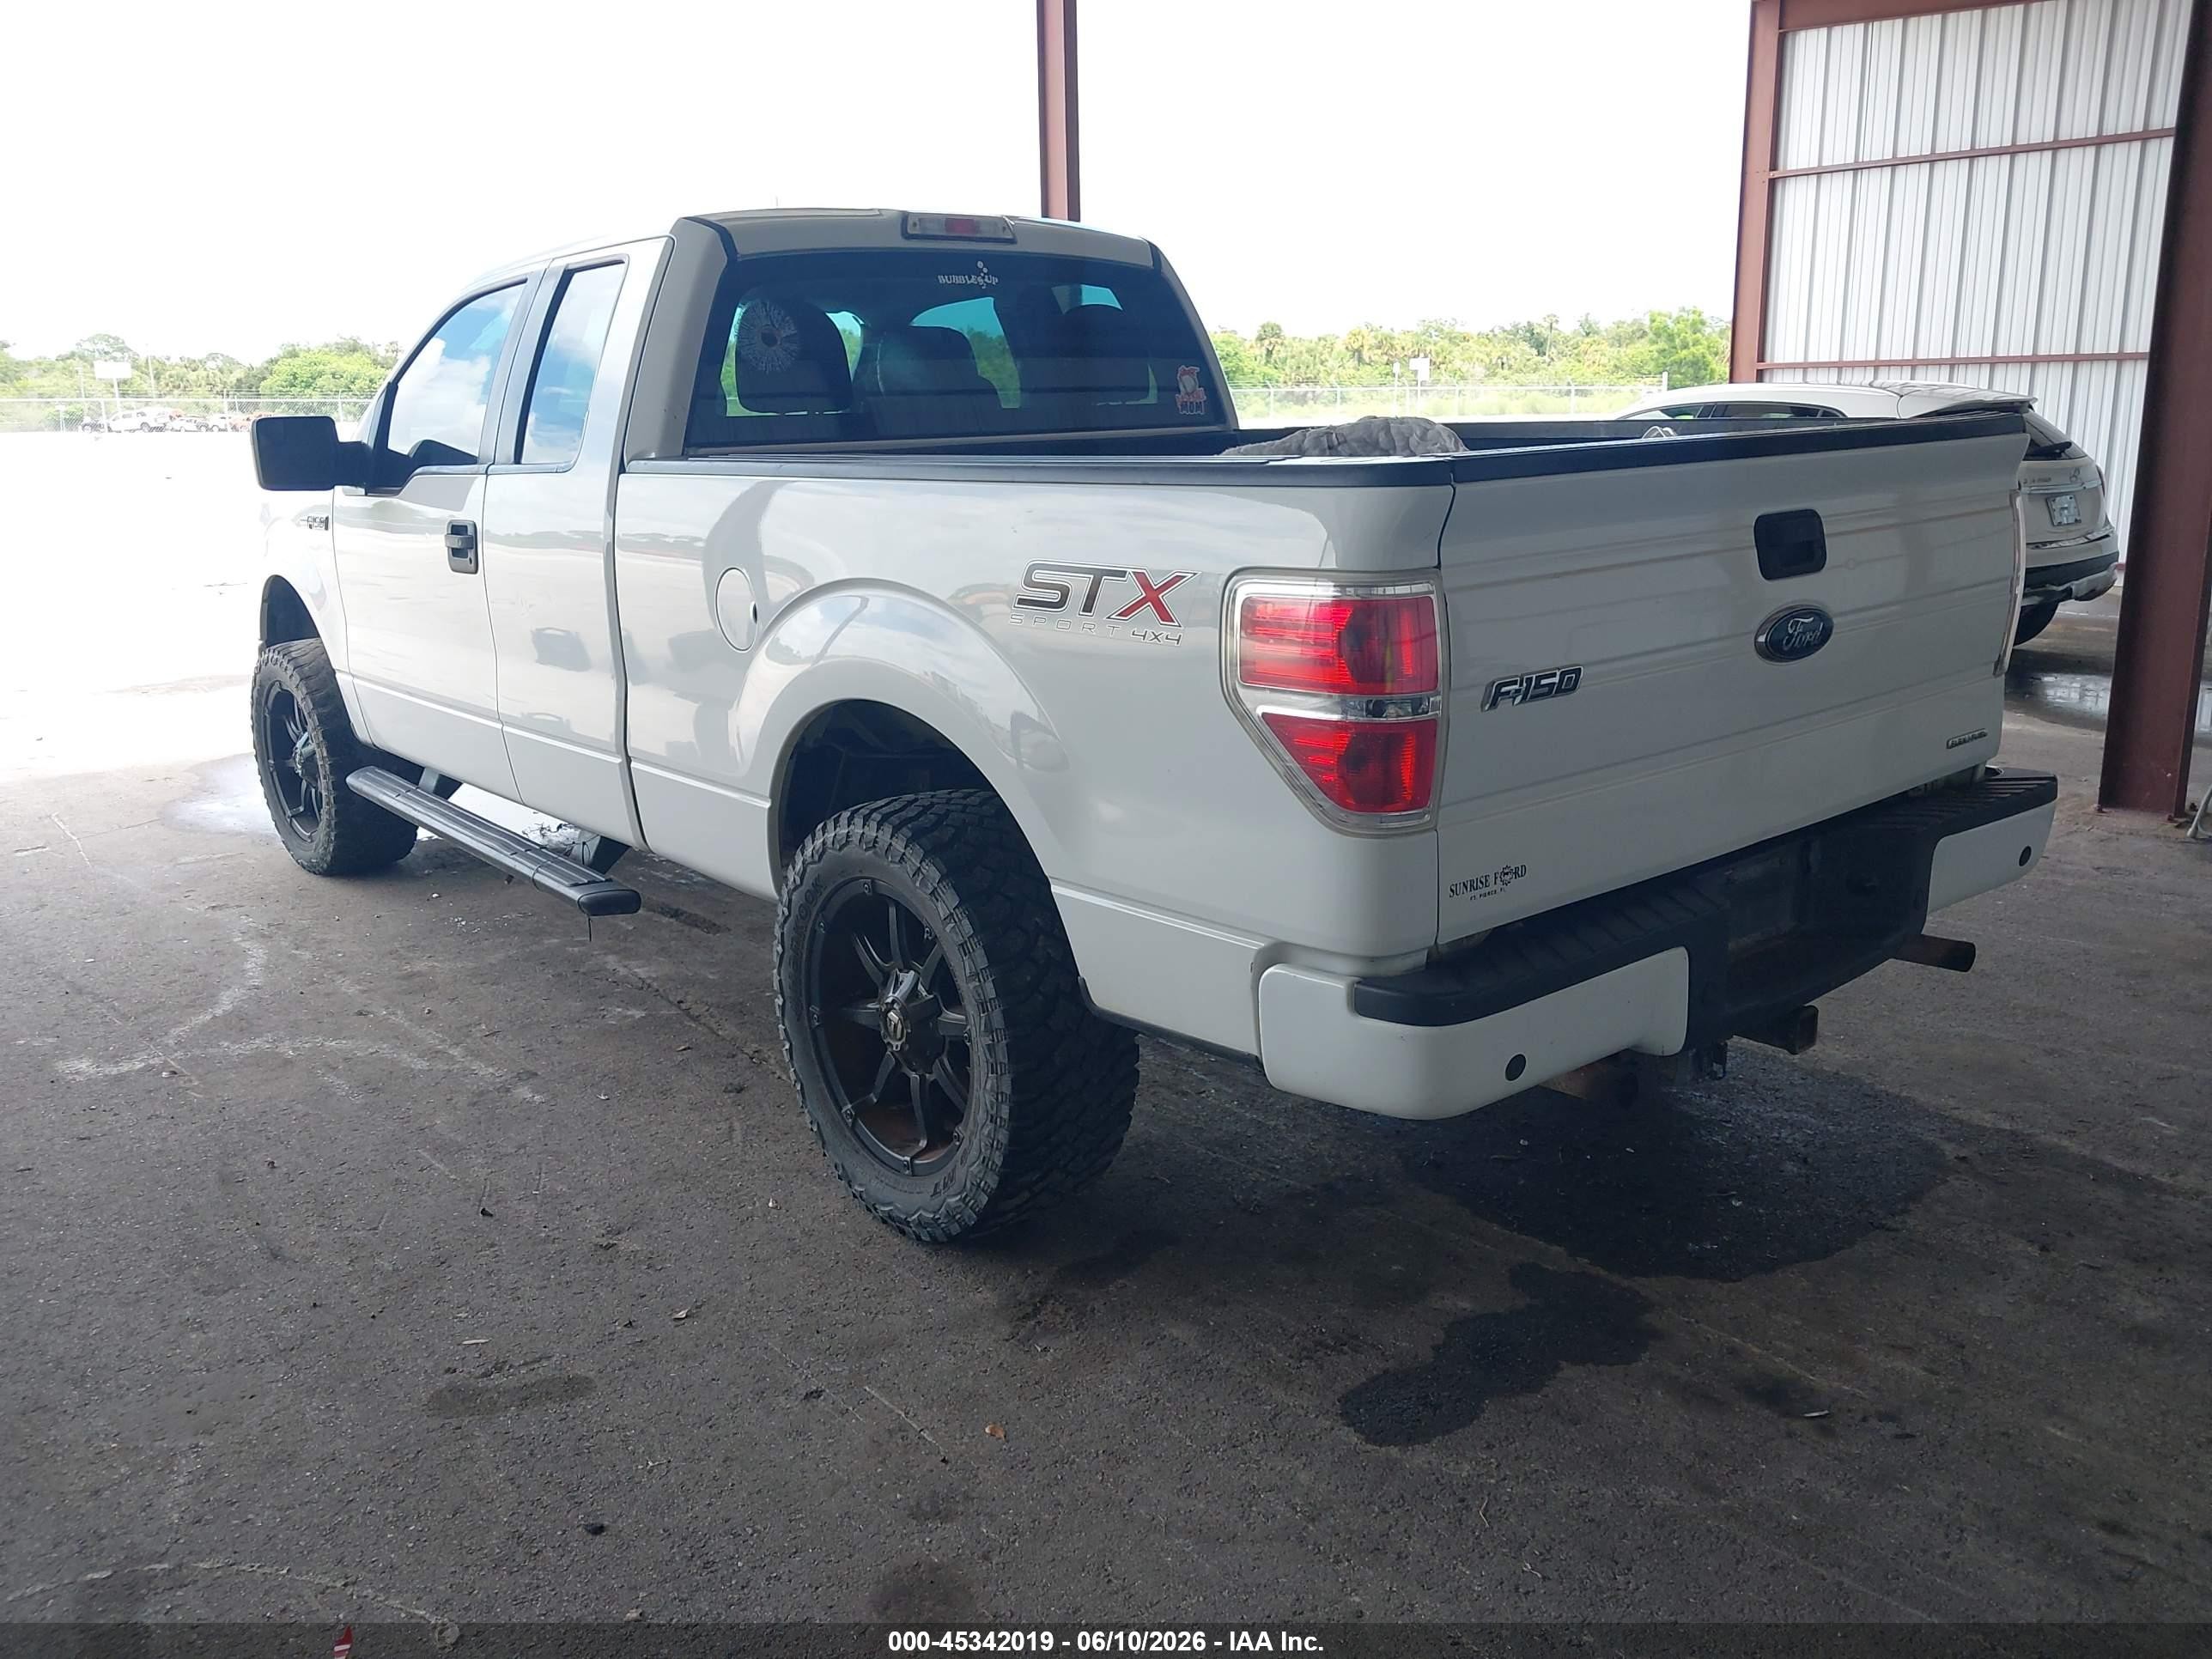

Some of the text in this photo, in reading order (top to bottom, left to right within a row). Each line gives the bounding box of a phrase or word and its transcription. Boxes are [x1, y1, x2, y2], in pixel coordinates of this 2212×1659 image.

[1013, 559, 1202, 628] STX
[1010, 613, 1121, 637] SPORT
[1449, 864, 1528, 898] SUNRISE FORD
